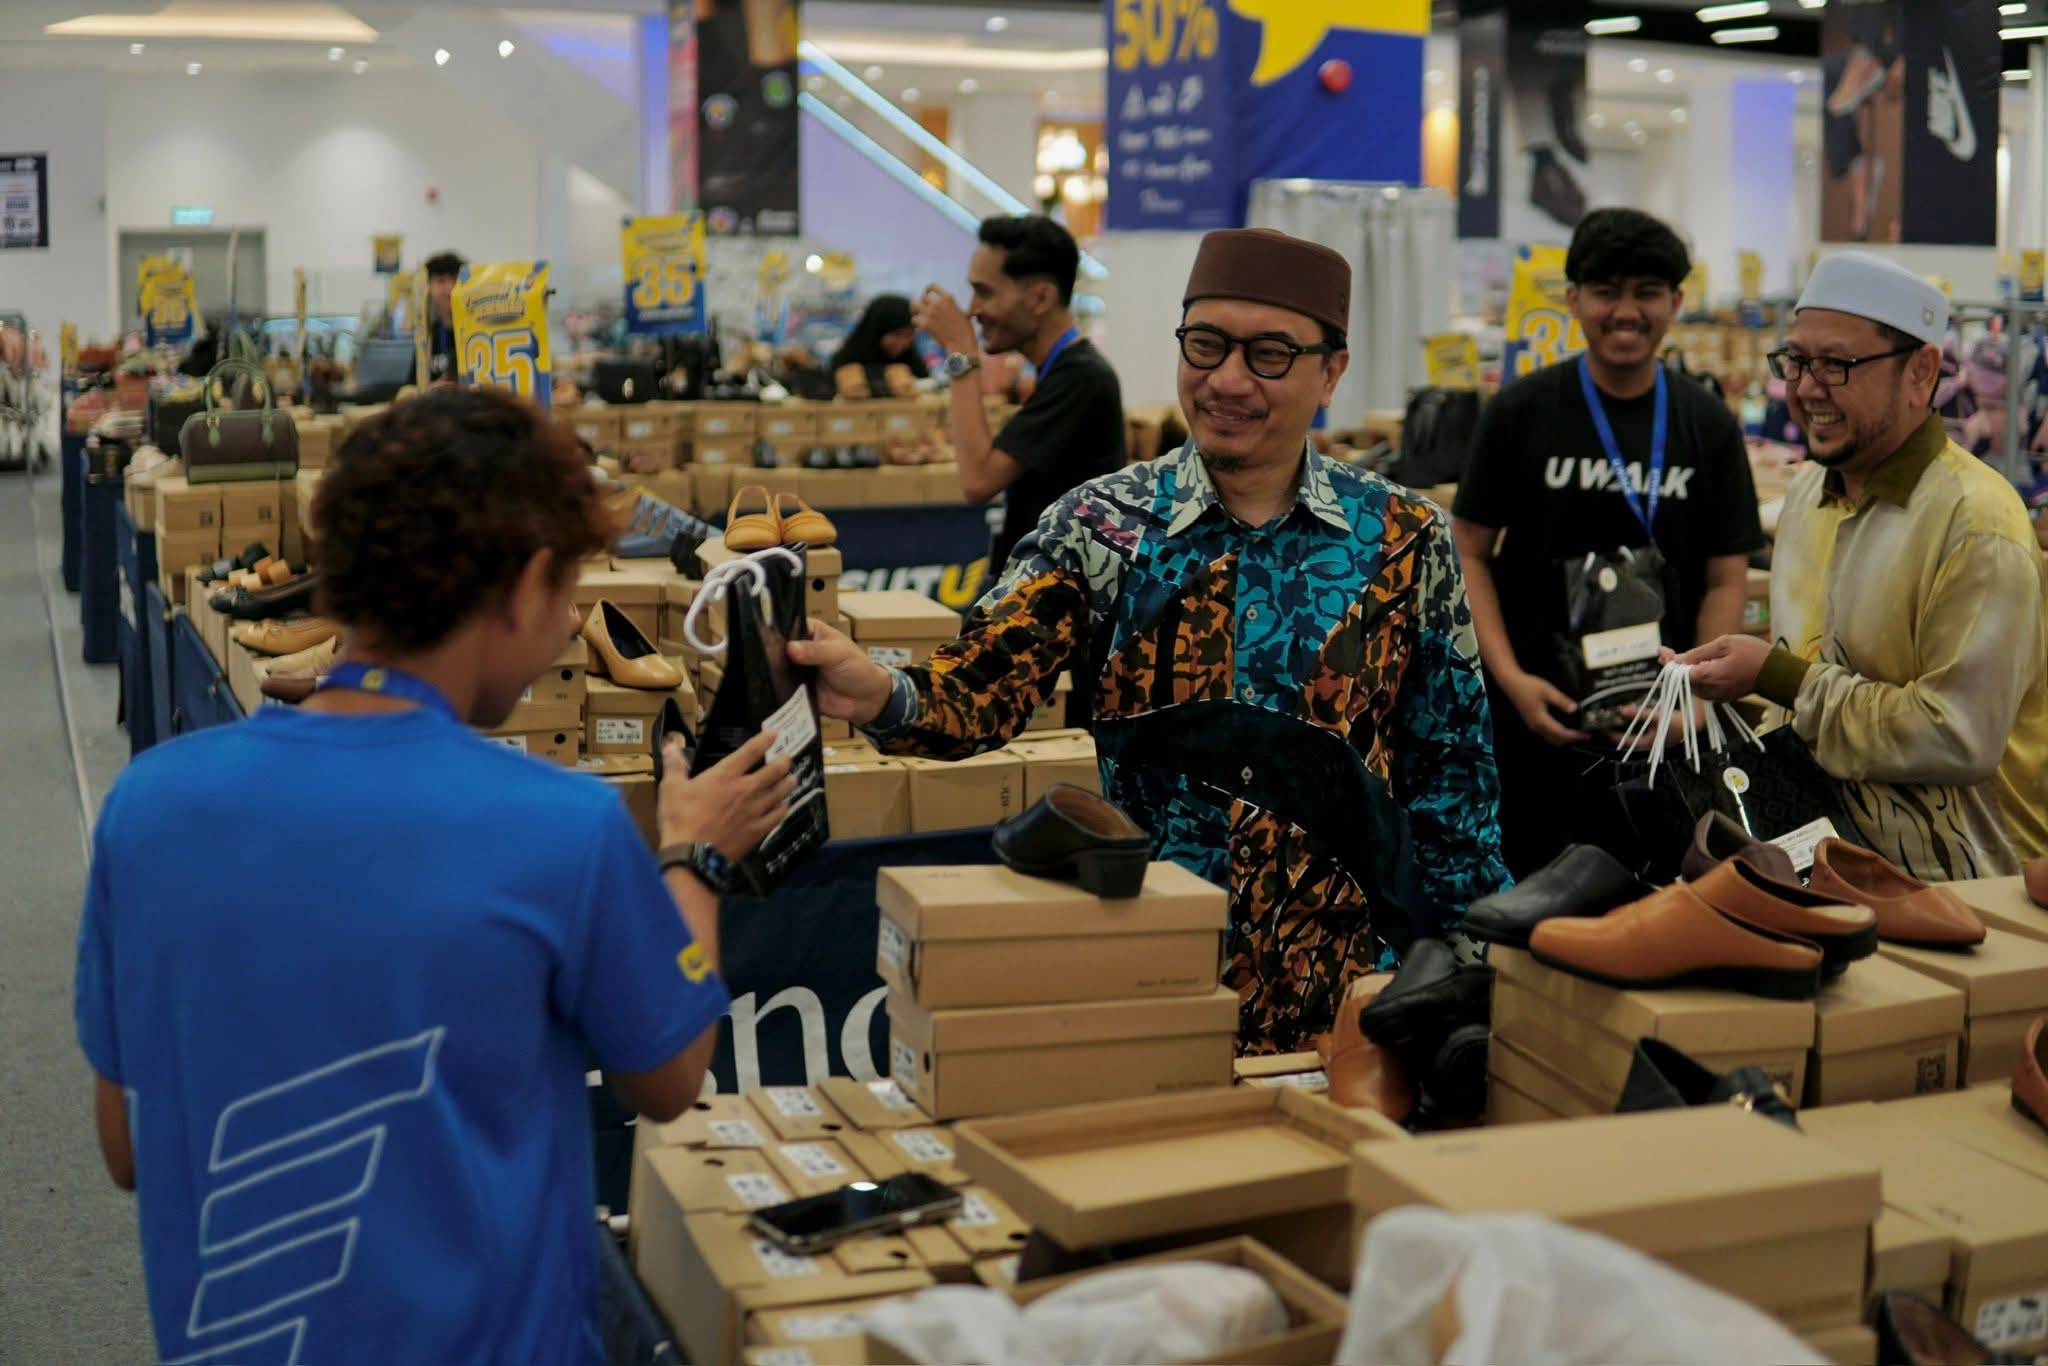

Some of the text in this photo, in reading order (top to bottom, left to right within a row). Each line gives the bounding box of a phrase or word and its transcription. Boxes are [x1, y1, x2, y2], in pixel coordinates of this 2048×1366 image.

[1113, 0, 1219, 70] 50%
[632, 257, 696, 309] 35
[466, 330, 535, 396] 35
